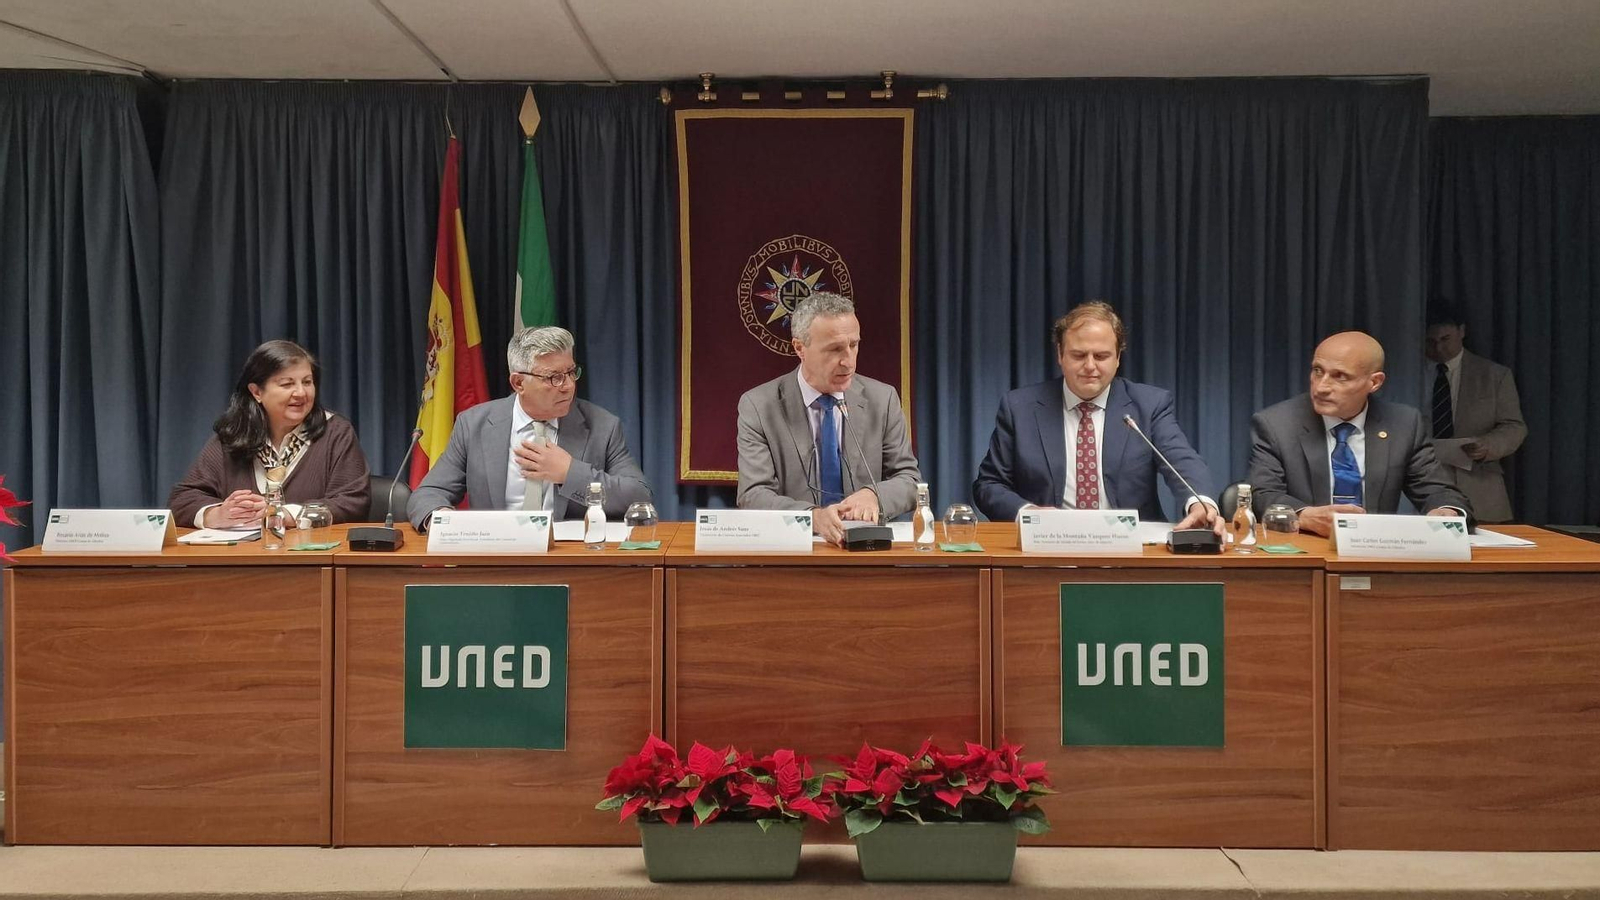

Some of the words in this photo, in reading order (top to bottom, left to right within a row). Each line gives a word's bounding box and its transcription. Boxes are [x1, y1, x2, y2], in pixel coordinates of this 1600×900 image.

[740, 266, 757, 322] OMNIBVS
[759, 236, 832, 262] MOBILIBVS
[834, 264, 851, 300] MOBI
[421, 645, 551, 688] UNED
[1077, 643, 1209, 686] UNED
